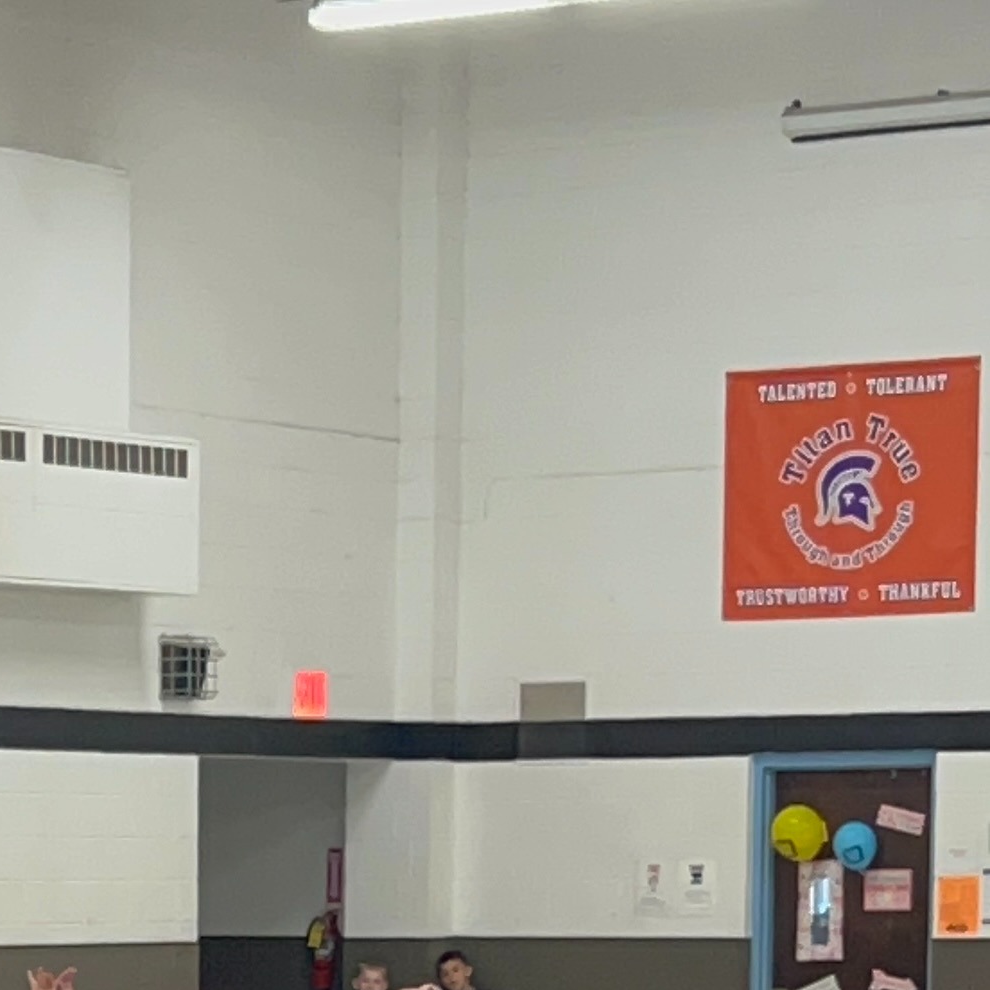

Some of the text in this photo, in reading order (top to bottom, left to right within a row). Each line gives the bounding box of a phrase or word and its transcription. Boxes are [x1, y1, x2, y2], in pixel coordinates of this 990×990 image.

[757, 373, 948, 403] TALENTED TOLERANT
[780, 414, 919, 482] Titan True
[783, 502, 912, 567] Through and Through
[735, 580, 961, 606] TRUSTWORTHY THANKFUL
